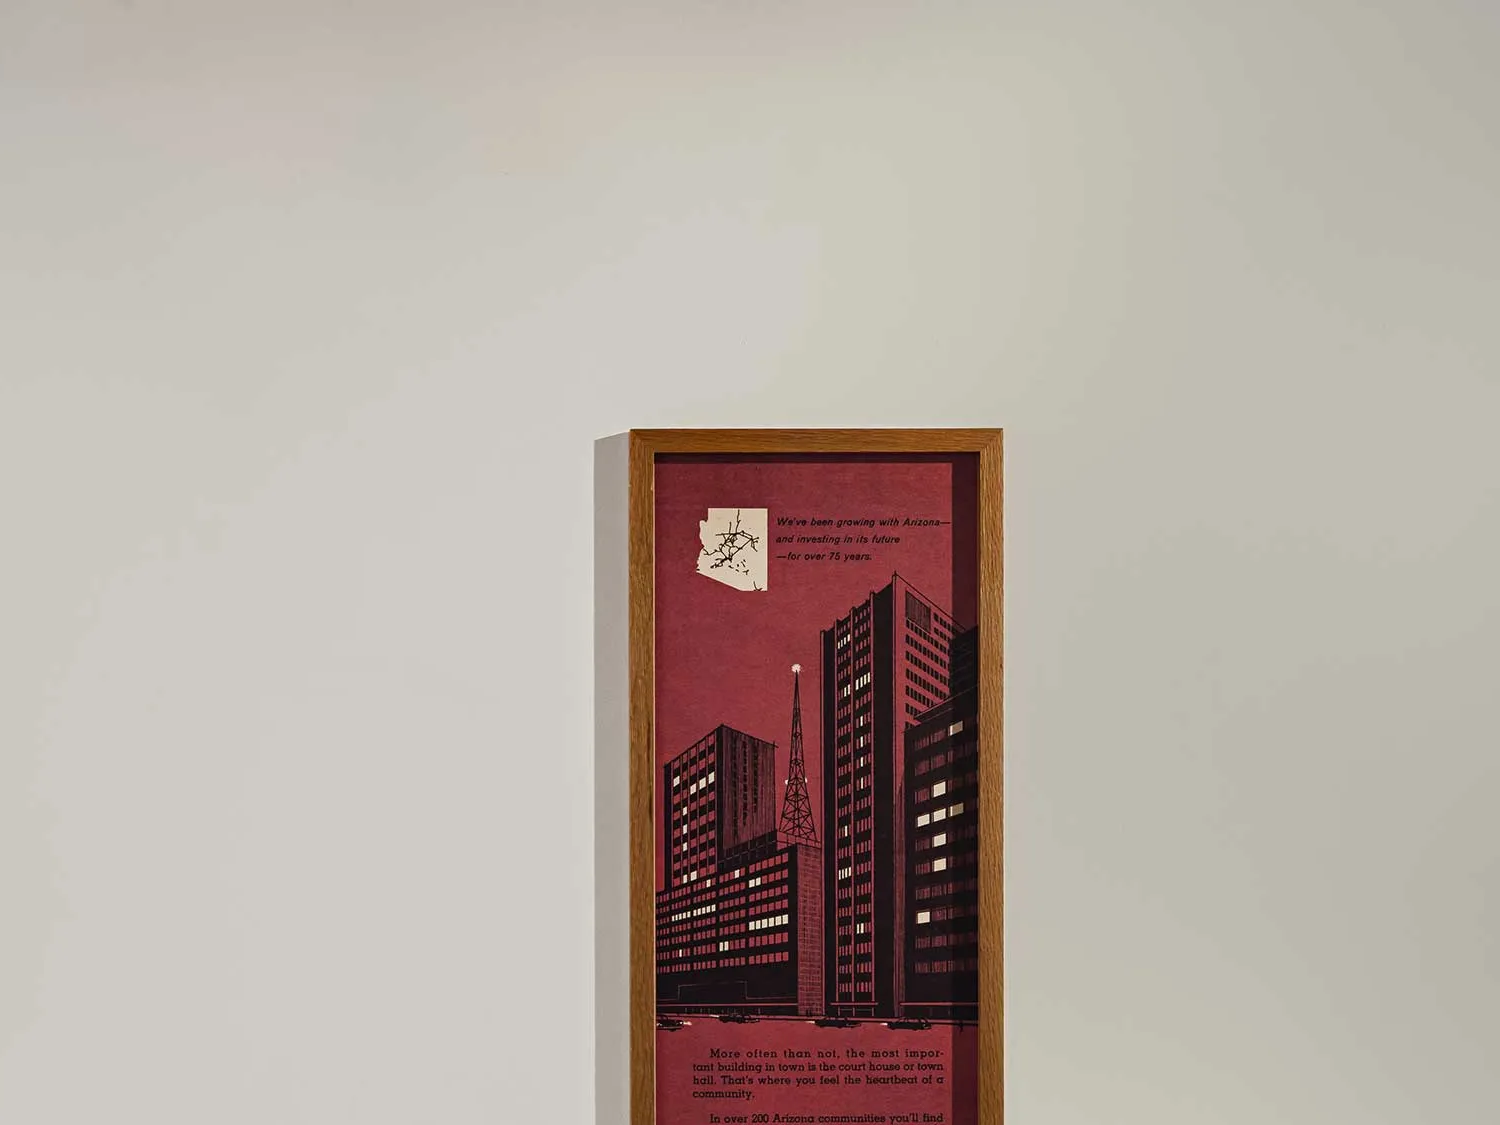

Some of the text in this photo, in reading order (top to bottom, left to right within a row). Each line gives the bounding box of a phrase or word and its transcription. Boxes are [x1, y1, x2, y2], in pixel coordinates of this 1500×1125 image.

[776, 518, 807, 527] We've
[810, 518, 834, 527] been
[836, 518, 877, 529] growing
[879, 518, 899, 527] with
[775, 535, 900, 546] and investing in its future
[828, 552, 840, 561] 75
[843, 554, 873, 563] years.
[710, 1048, 741, 1058] More
[746, 1048, 778, 1058] often
[784, 1048, 811, 1058] than
[846, 1048, 865, 1058] the
[871, 1048, 900, 1058] most
[693, 1062, 944, 1074] tant building in town is the court house or town
[693, 1075, 944, 1087] hall. That's where you feel the heartbeat of a
[693, 1089, 755, 1100] community.
[710, 1114, 720, 1123] In
[751, 1114, 769, 1123] 200
[772, 1114, 815, 1123] Arizona
[818, 1114, 886, 1123] communities
[889, 1114, 919, 1125] you'll
[922, 1114, 944, 1123] find
